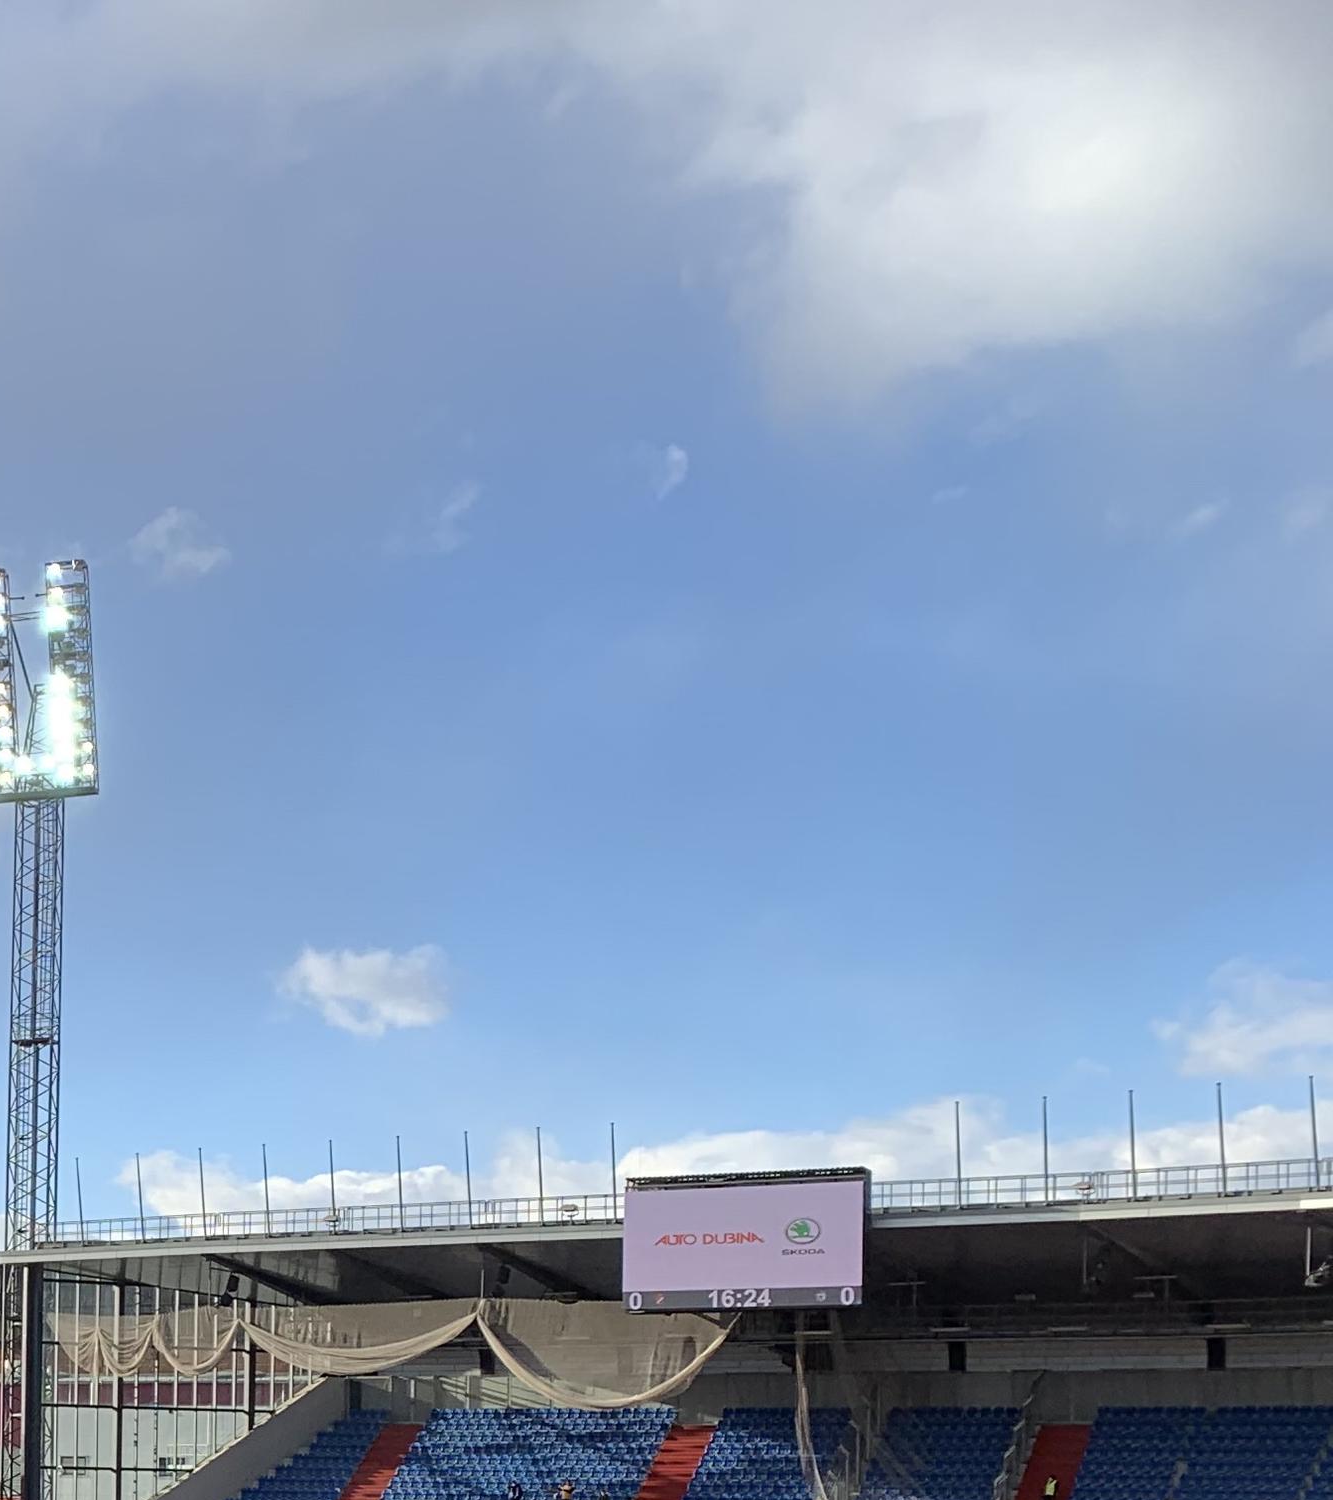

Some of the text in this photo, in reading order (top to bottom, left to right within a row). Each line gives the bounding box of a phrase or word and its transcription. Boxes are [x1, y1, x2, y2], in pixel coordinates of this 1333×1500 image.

[654, 1232, 765, 1246] AUTO DUBINA
[629, 1286, 855, 1310] 0 16:24 0
